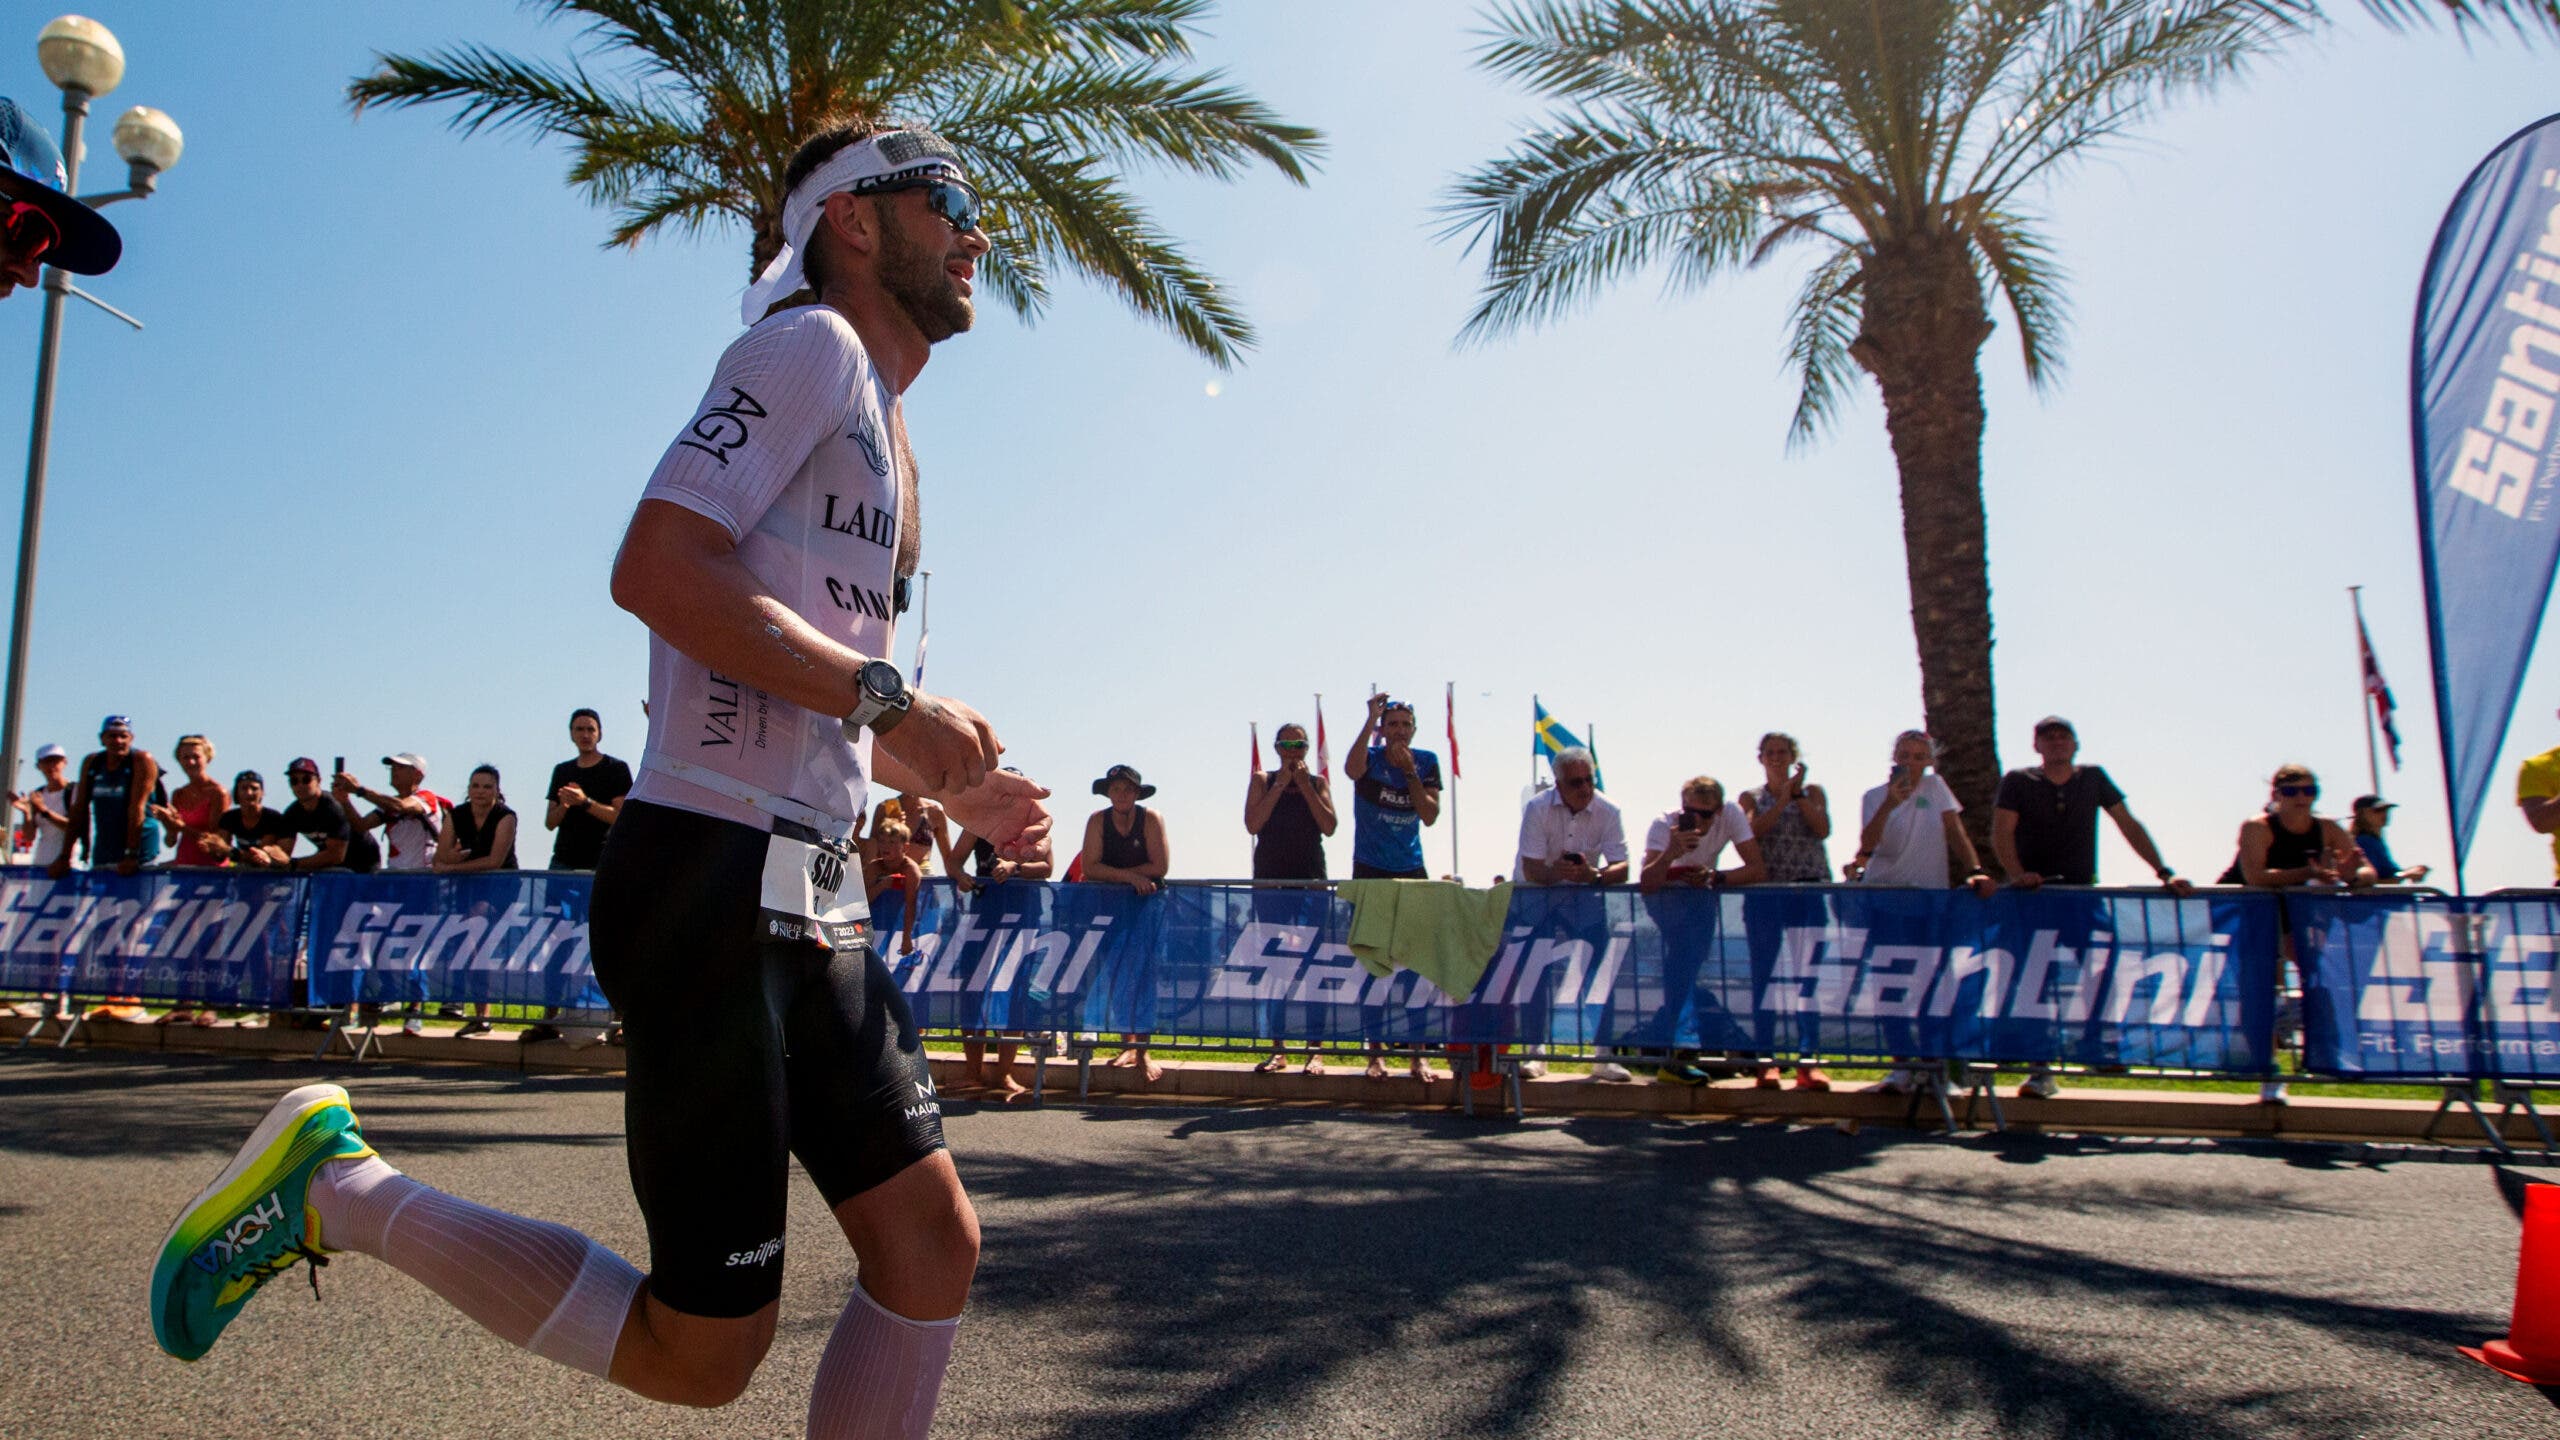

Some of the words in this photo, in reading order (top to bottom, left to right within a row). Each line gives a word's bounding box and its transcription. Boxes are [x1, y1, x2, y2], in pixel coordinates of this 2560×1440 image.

[679, 386, 768, 470] AG1
[825, 576, 891, 622] CAN
[755, 717, 768, 749] Driven
[757, 703, 769, 714] by
[324, 900, 598, 976] Santin
[1759, 926, 2232, 1027] Santini
[192, 1191, 285, 1274] HOKA
